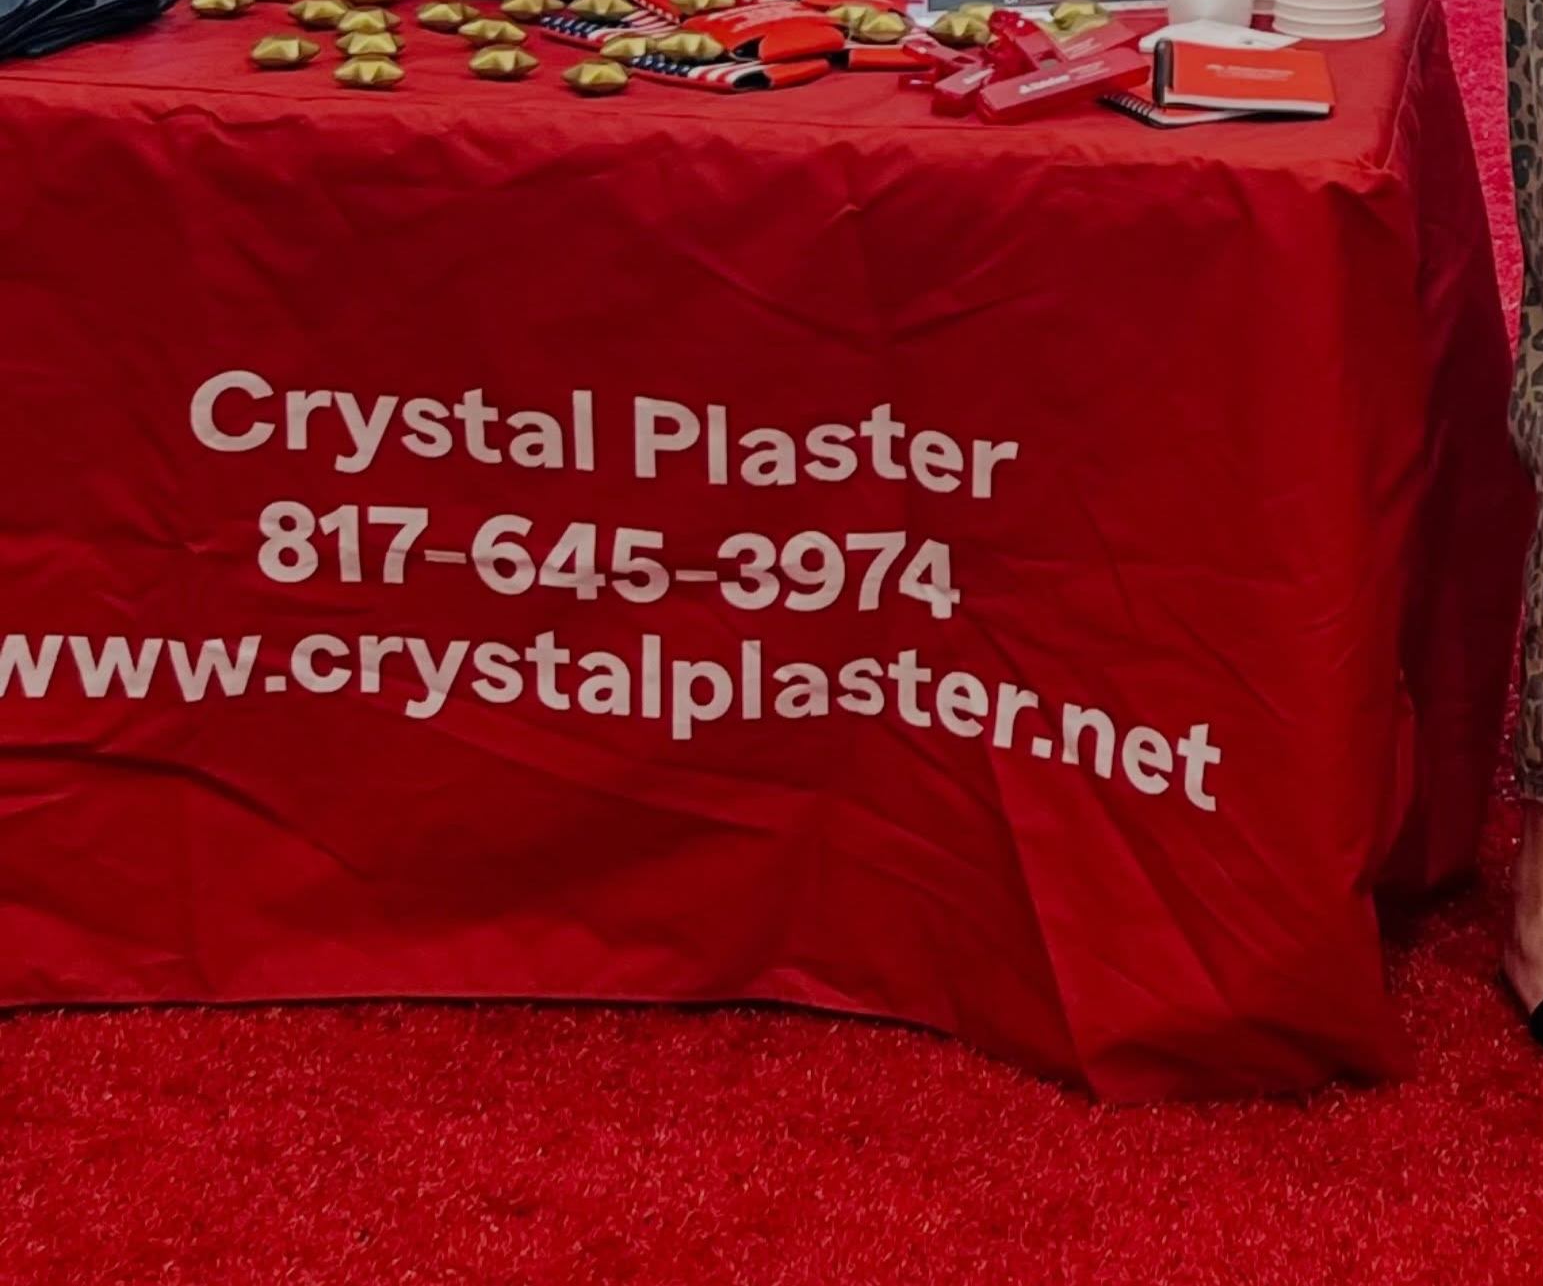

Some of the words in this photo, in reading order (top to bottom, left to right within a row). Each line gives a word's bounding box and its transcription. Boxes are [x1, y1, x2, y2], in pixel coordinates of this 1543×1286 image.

[190, 369, 595, 474] Crystal
[633, 395, 1019, 500] Plaster
[256, 501, 961, 620] 817-645-3974
[0, 632, 1222, 813] www.crystalplaster.net
